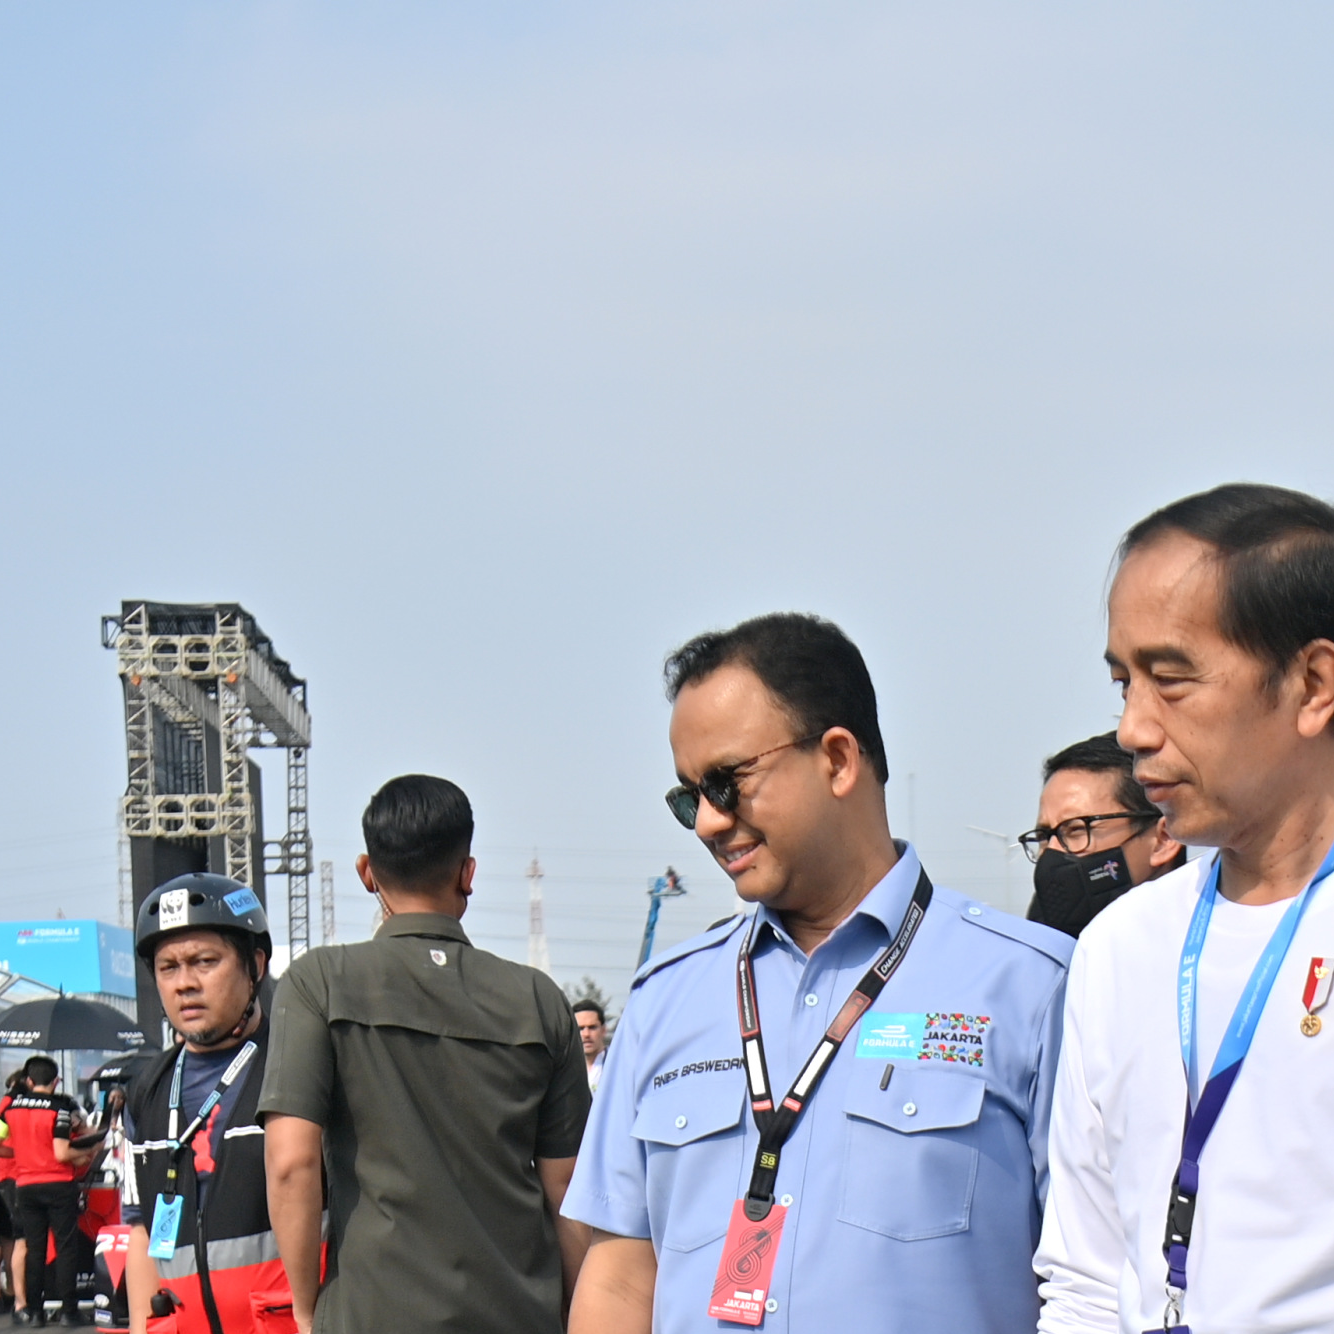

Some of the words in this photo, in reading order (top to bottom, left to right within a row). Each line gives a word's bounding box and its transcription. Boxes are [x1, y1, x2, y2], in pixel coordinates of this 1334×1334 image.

[880, 946, 902, 975] CHANGE
[1180, 966, 1195, 1047] FORMULA
[863, 1038, 906, 1048] FORMULA
[923, 1030, 983, 1046] JAKARTA
[653, 1068, 680, 1091] ANIES
[681, 1057, 746, 1078] BASWEDAN
[760, 1154, 776, 1166] S8
[723, 1298, 760, 1312] JAKARTA
